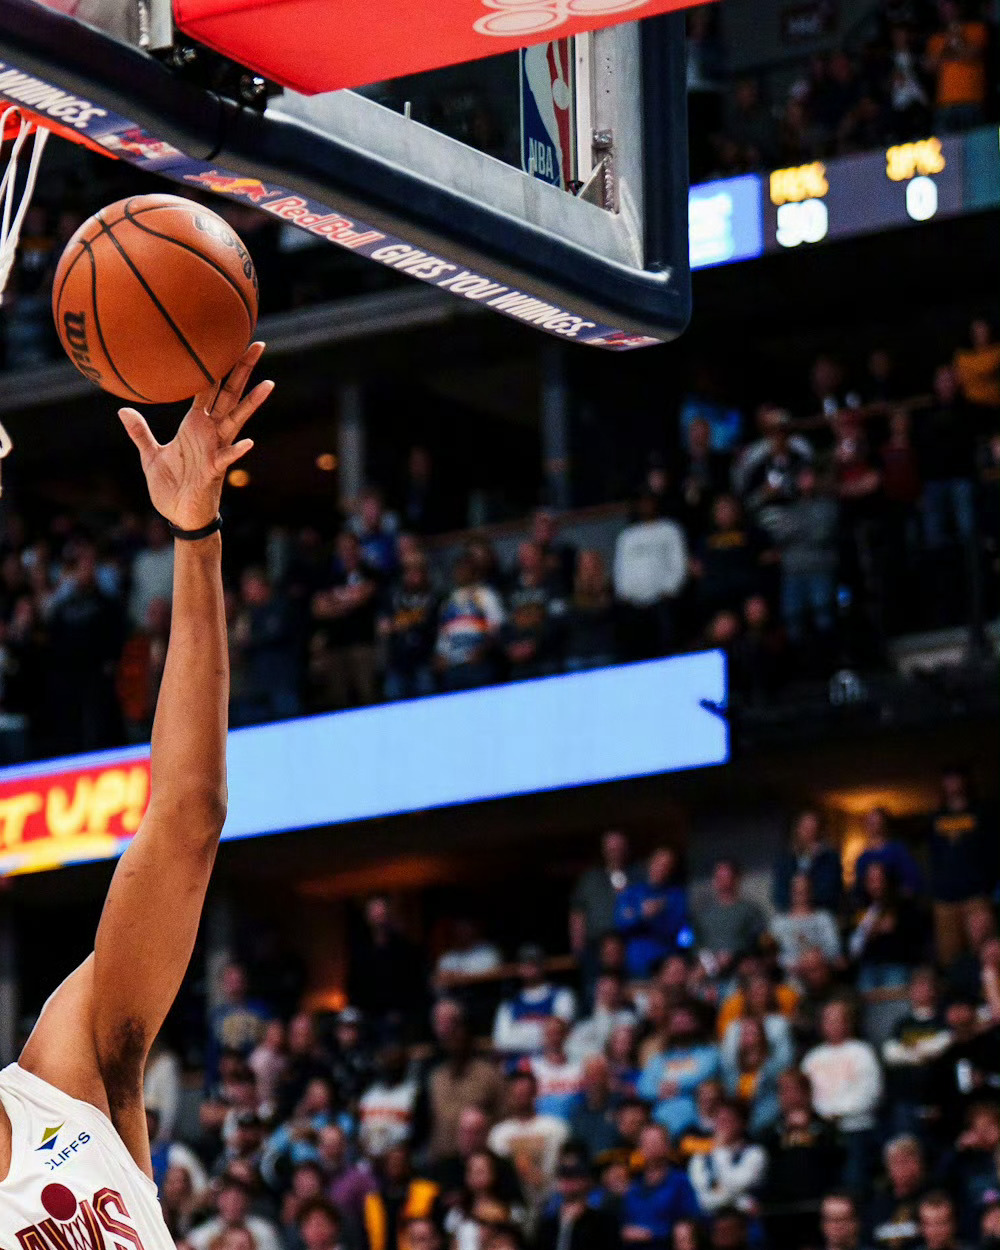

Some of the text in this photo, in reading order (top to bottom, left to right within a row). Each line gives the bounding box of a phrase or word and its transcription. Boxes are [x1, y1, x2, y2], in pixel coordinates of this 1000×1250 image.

[528, 136, 554, 180] NBA
[905, 175, 938, 221] 0
[370, 244, 456, 278] GIVES
[436, 270, 509, 300] YOU
[46, 766, 149, 838] UP!
